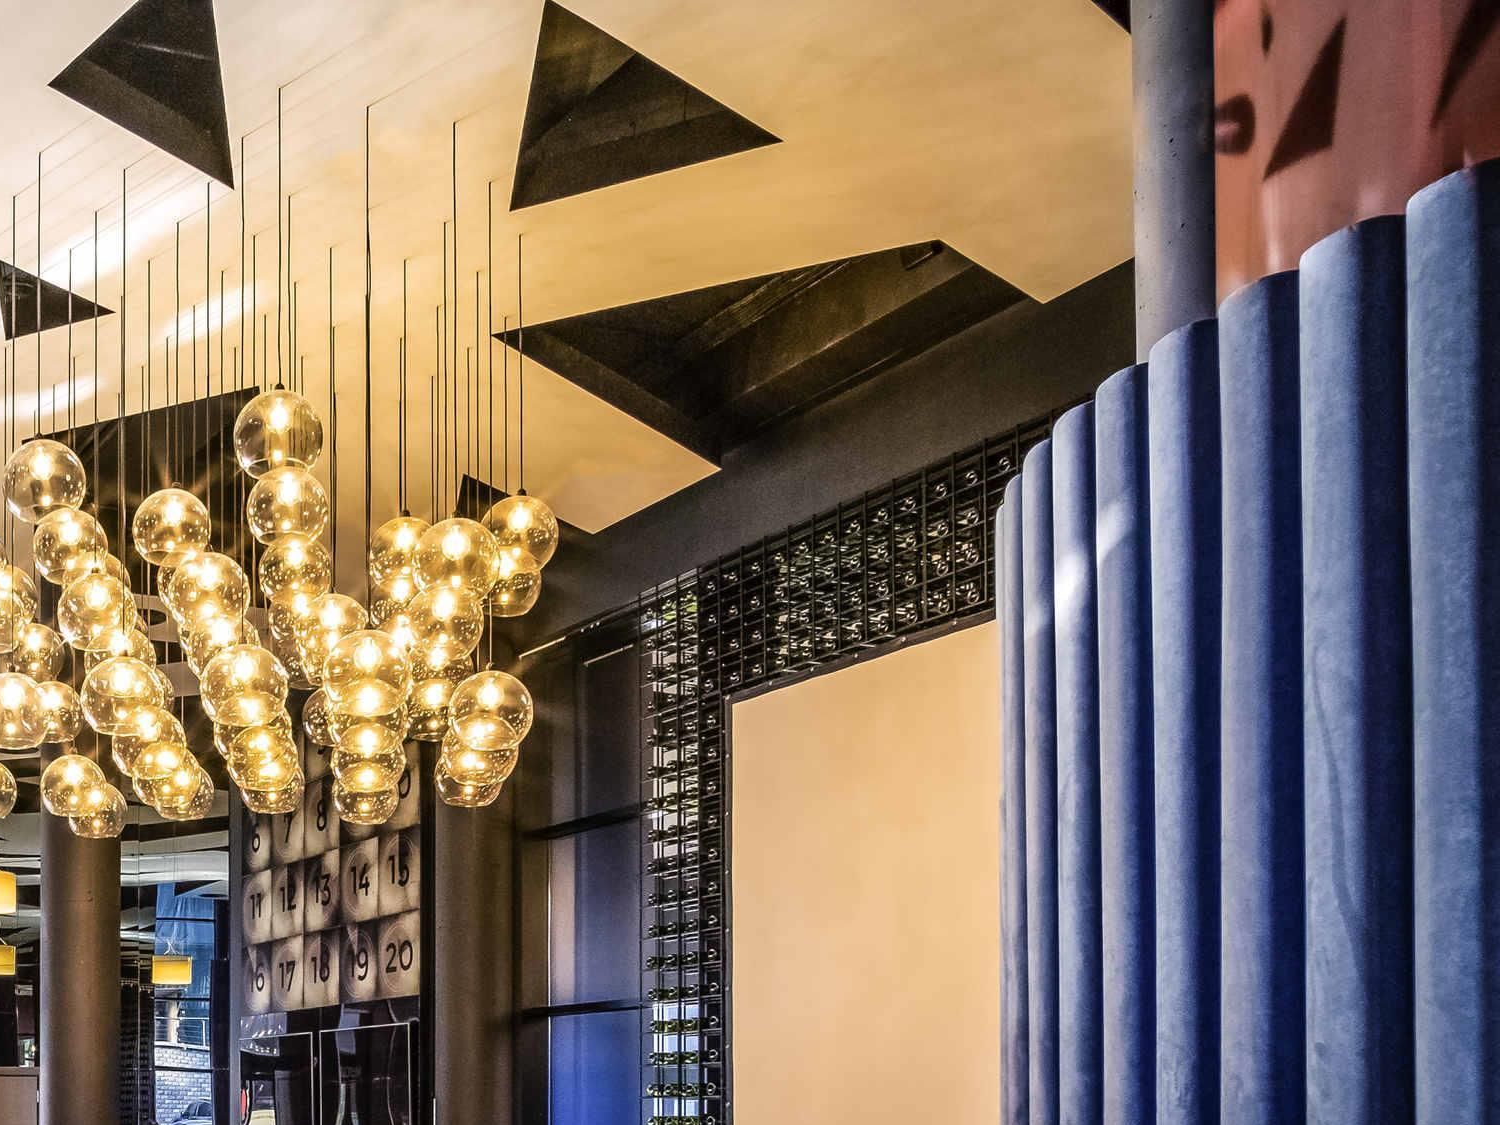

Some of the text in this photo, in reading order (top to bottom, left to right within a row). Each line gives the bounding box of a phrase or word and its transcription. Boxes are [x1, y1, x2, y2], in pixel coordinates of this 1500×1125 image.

[316, 800, 327, 832] 8
[249, 849, 410, 920] 11 12 13 14 15
[250, 939, 414, 993] 16 17 18 19 20
